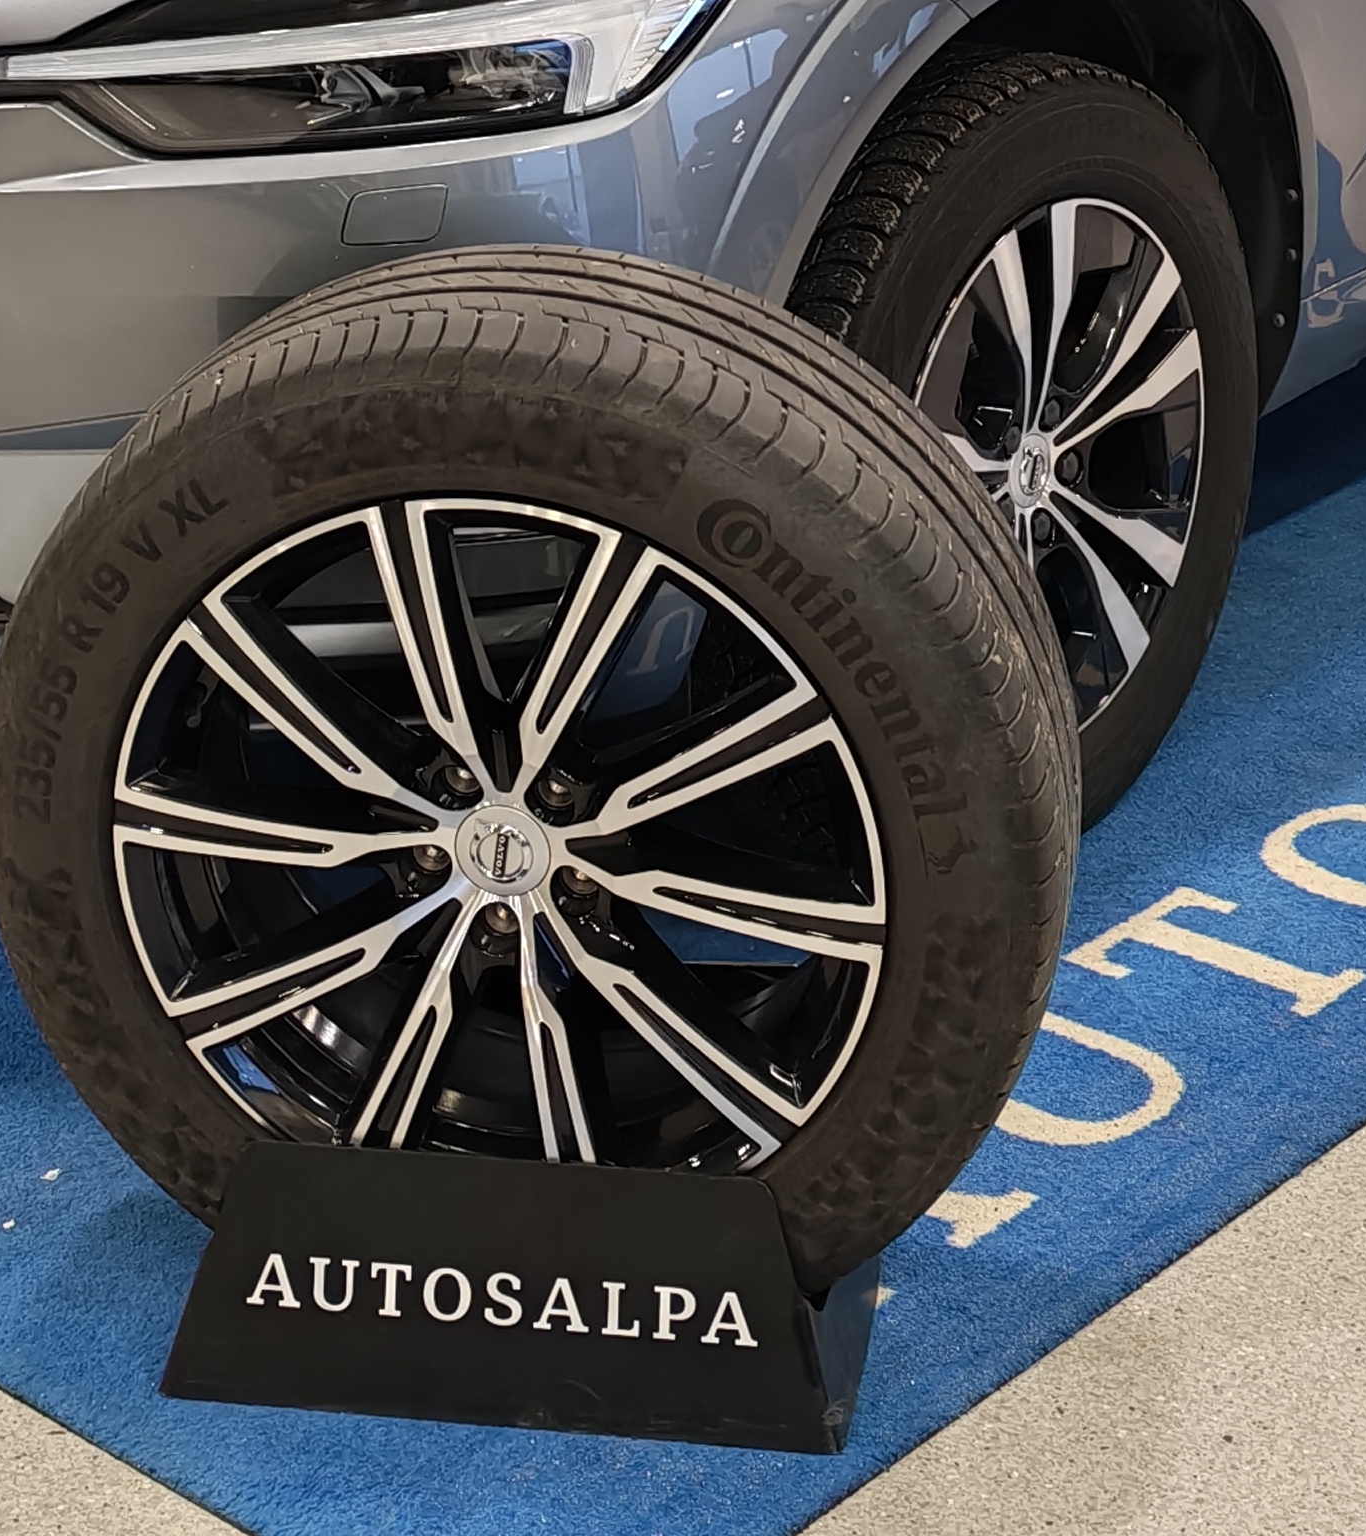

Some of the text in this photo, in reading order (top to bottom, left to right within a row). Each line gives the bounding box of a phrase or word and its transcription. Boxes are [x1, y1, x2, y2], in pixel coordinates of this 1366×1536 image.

[119, 518, 163, 563] V
[157, 477, 230, 538] XL
[695, 497, 969, 822] Continental
[494, 835, 506, 875] VOLVO
[245, 1252, 759, 1348] AUTOSALPA
